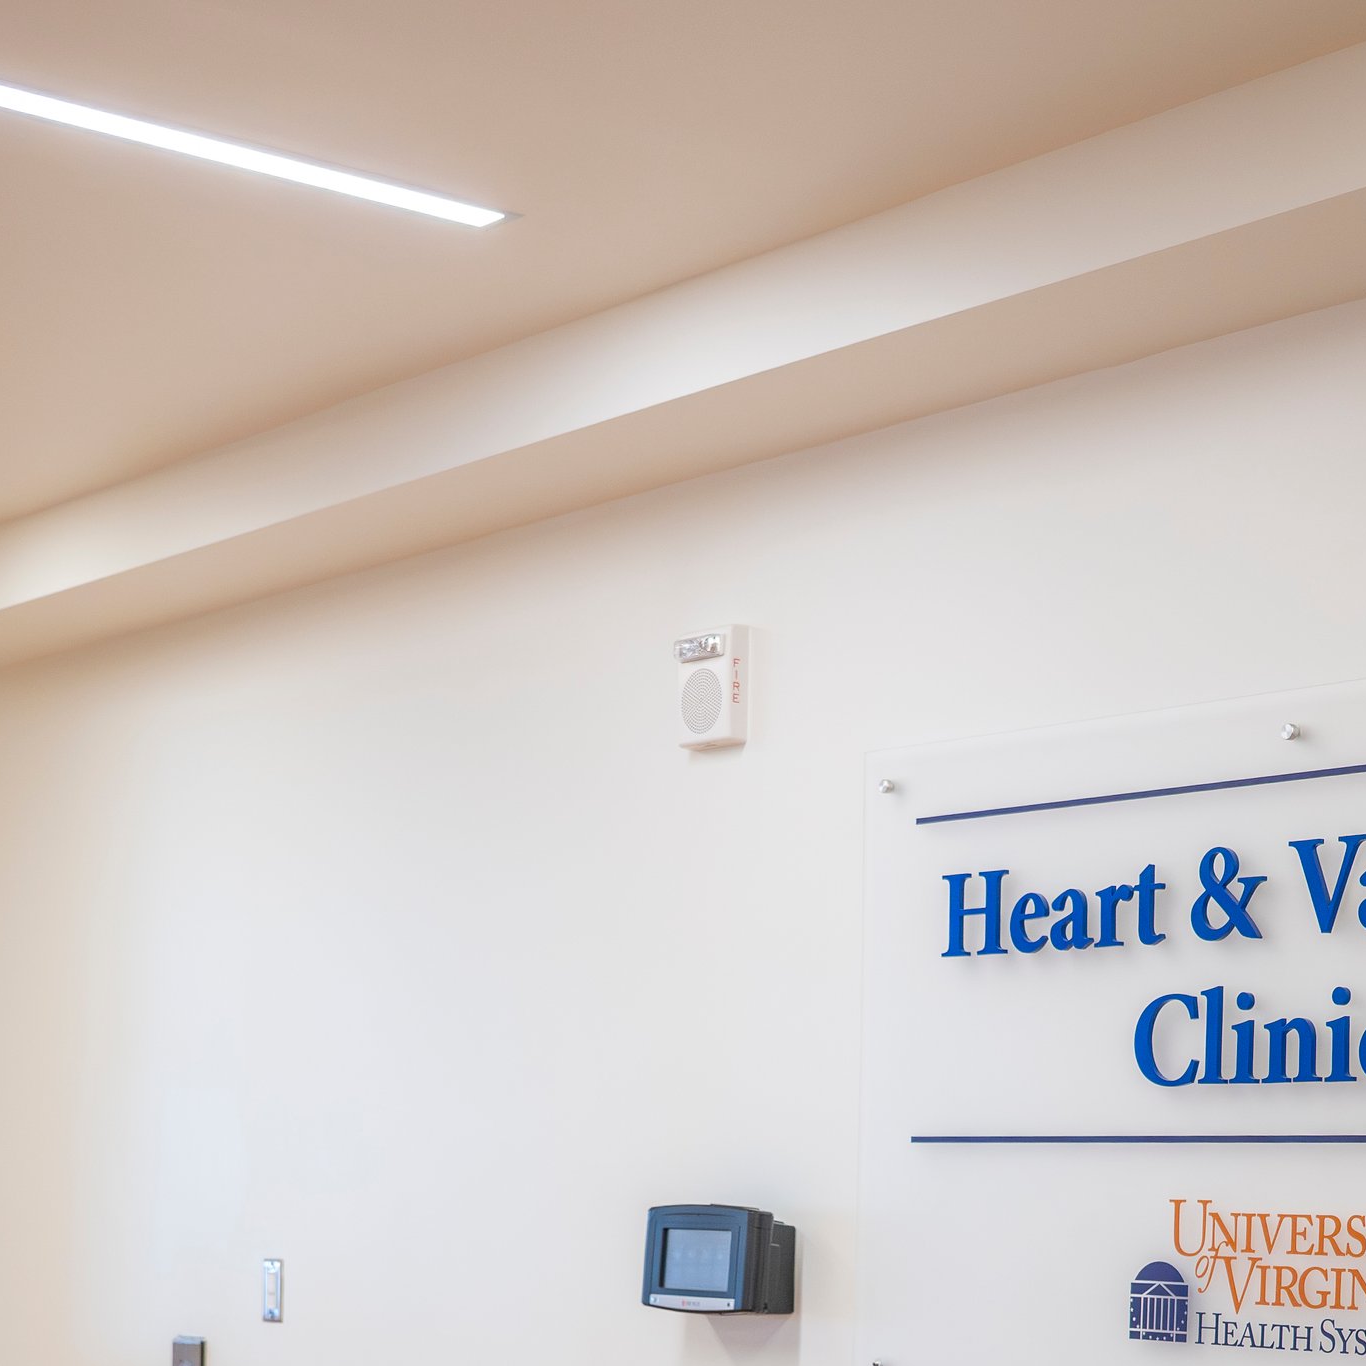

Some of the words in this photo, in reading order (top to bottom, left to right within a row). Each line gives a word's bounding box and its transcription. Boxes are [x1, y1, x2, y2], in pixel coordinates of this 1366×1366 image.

[732, 658, 741, 704] FIRE
[941, 864, 1166, 957] Heart
[1191, 847, 1267, 941] &
[1195, 1240, 1230, 1294] of
[1195, 1311, 1314, 1352] HEALTH
